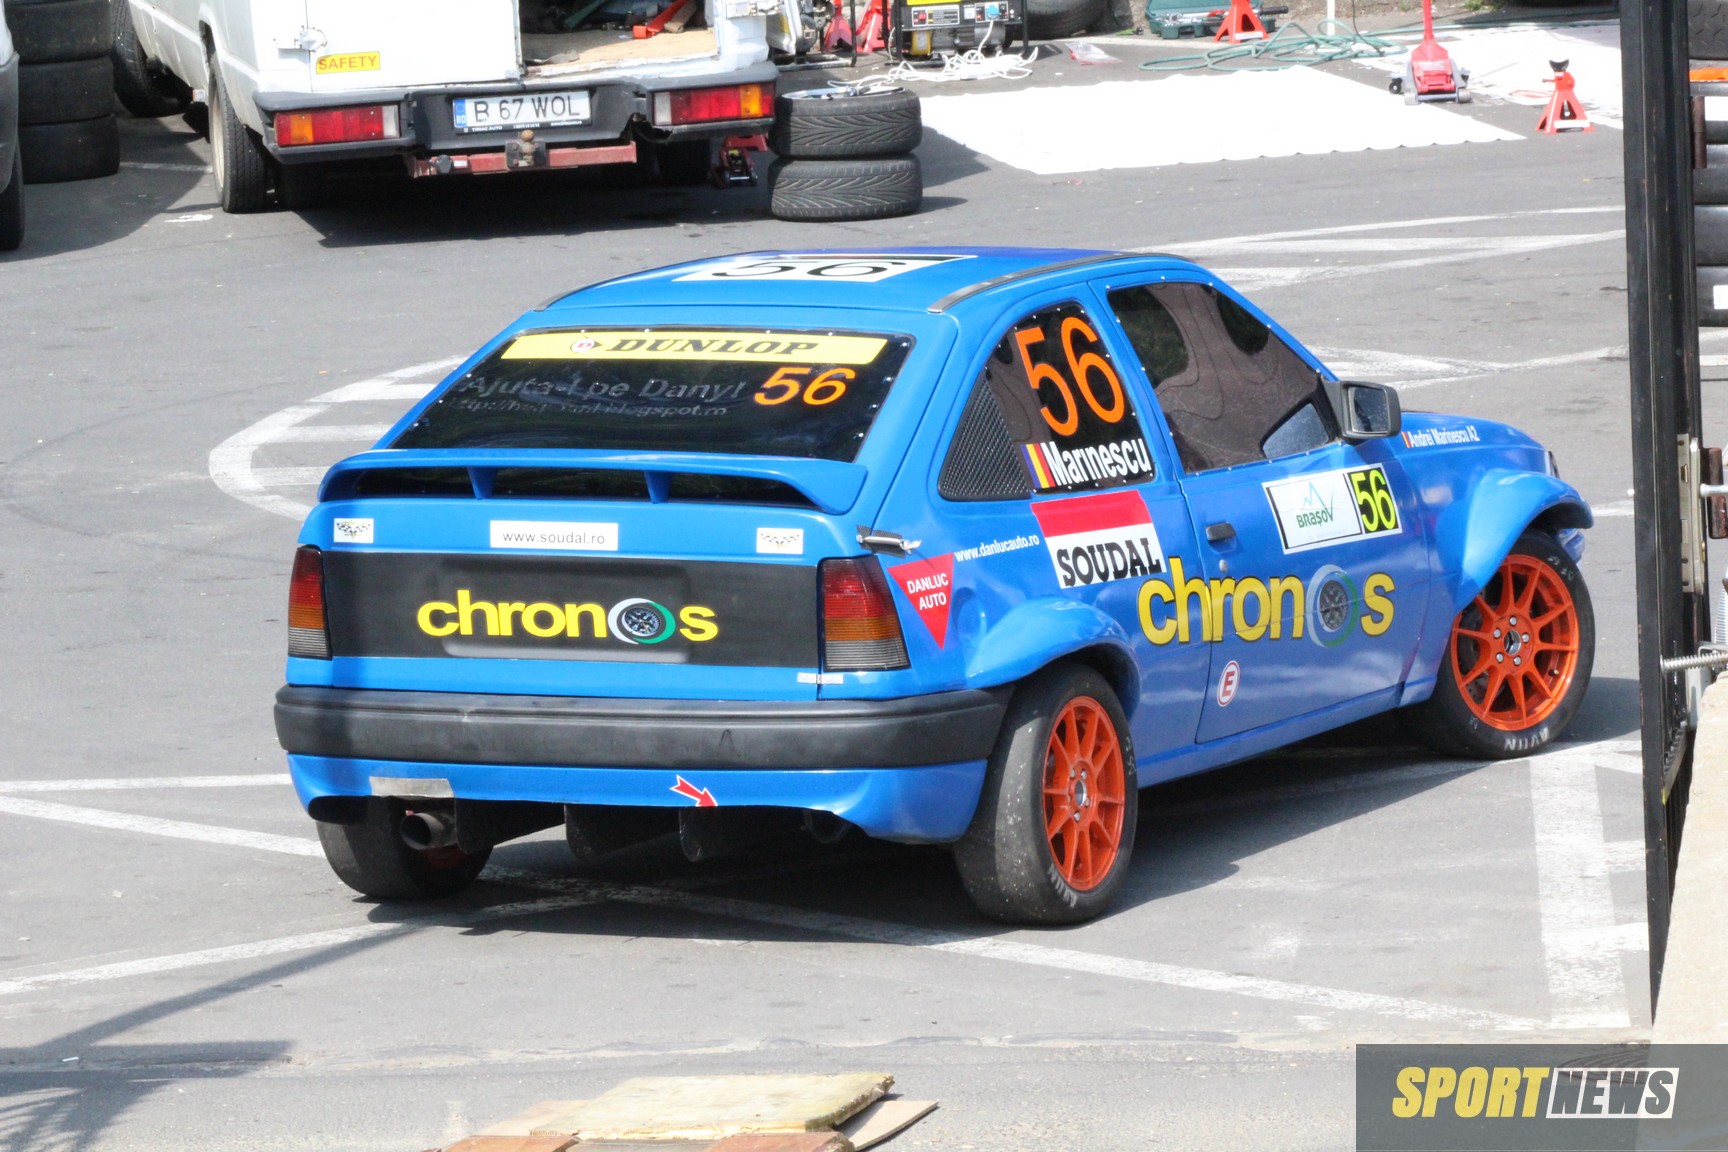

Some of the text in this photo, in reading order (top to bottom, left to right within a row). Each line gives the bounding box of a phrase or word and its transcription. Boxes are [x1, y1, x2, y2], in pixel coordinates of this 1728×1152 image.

[318, 55, 377, 70] SAFETY
[456, 115, 466, 125] RO
[474, 95, 580, 122] B 67 WOL
[711, 260, 907, 278] 56
[606, 338, 819, 355] DUNLOP
[754, 367, 857, 407] 56
[1015, 316, 1126, 437] 56
[583, 381, 630, 401] pe
[638, 379, 748, 403] Dany!
[1407, 428, 1436, 448] Andrei
[1430, 428, 1470, 445] Marinescu
[1040, 438, 1152, 487] Marinescu
[1350, 469, 1397, 532] 56
[502, 531, 605, 545] www.soudal.ro
[954, 534, 1040, 562] www.danlucauto.ro
[1056, 537, 1162, 587] SOUDAL
[906, 573, 949, 594] DANLUC
[919, 592, 947, 610] AUTO
[1221, 671, 1235, 697] E
